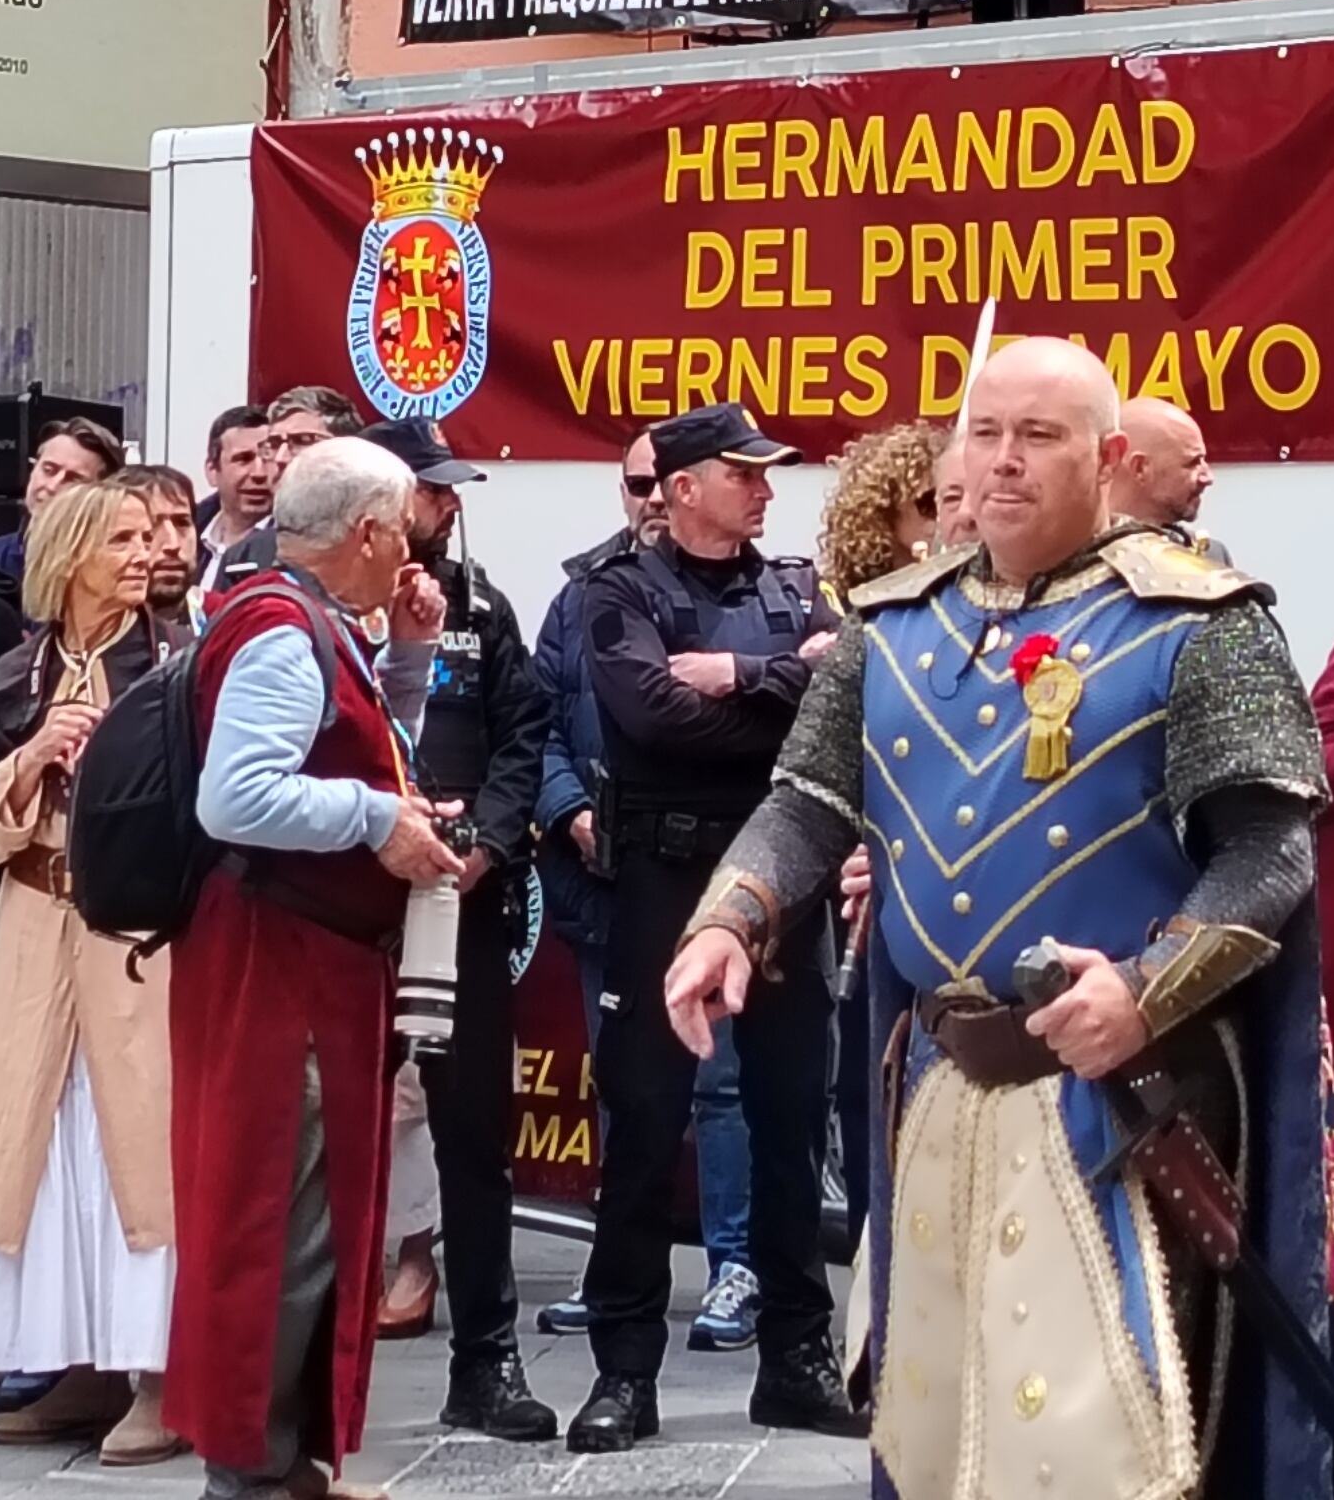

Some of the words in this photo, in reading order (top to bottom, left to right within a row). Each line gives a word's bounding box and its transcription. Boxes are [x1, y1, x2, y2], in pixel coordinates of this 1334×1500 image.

[665, 99, 1196, 204] HERMANDAD
[684, 228, 832, 309] DEL
[860, 216, 1178, 306] PRIMER
[553, 334, 889, 418] VIERNES
[921, 333, 1029, 416] D
[515, 1112, 592, 1165] MA
